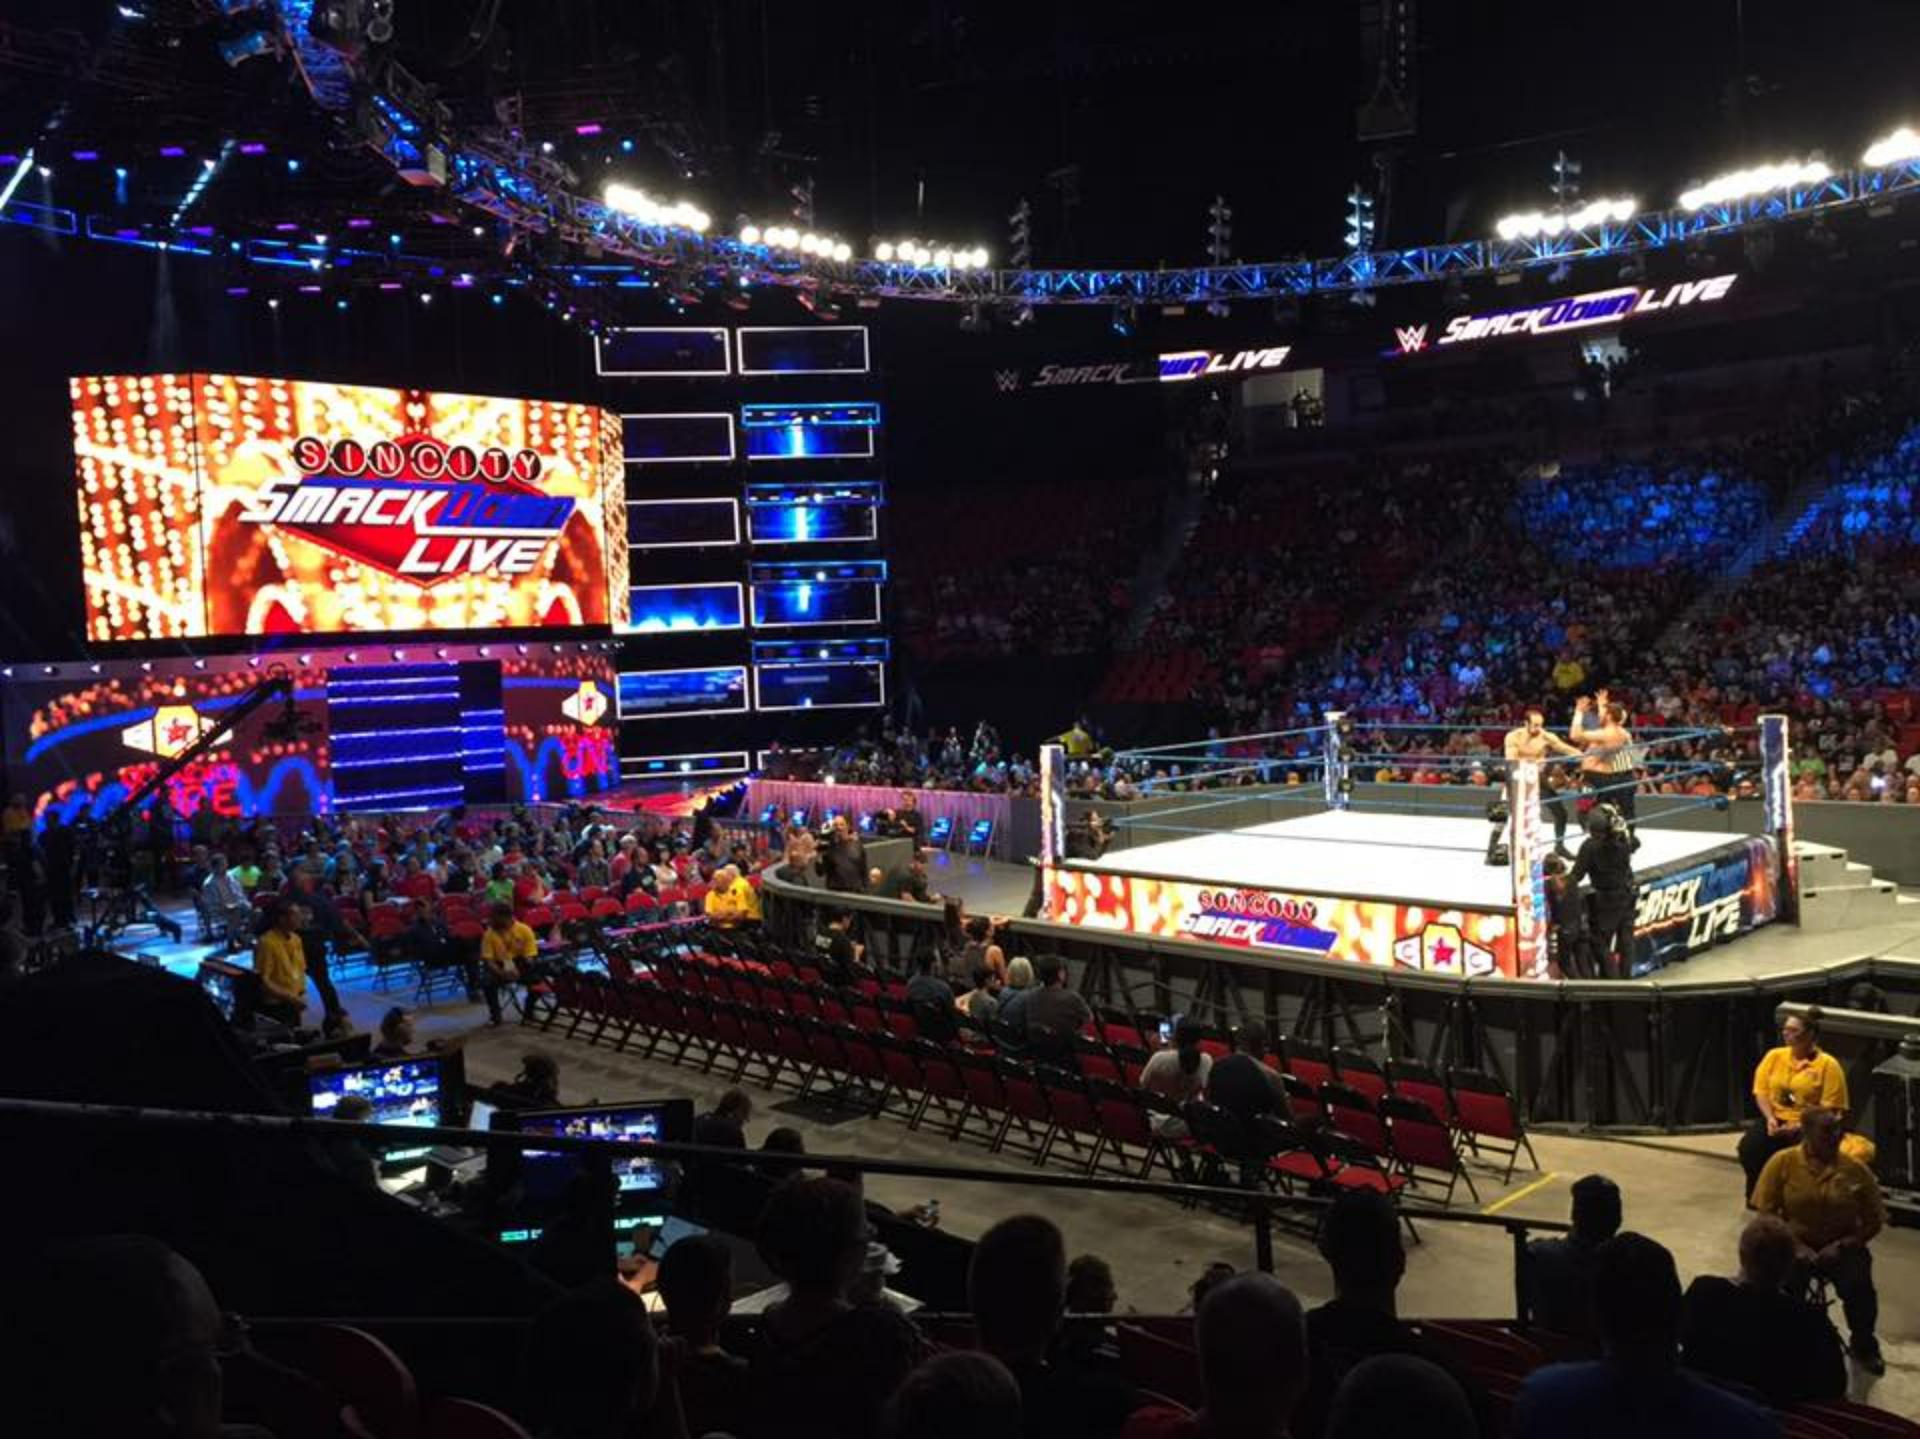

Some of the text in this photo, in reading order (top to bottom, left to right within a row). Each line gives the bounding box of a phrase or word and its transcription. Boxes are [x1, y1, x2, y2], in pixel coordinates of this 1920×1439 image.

[1635, 274, 1738, 312] LIVE
[1204, 346, 1292, 373] LIVE
[294, 437, 541, 482] SIN CITY
[397, 538, 543, 574] LIVE
[1687, 900, 1741, 948] LIVE
